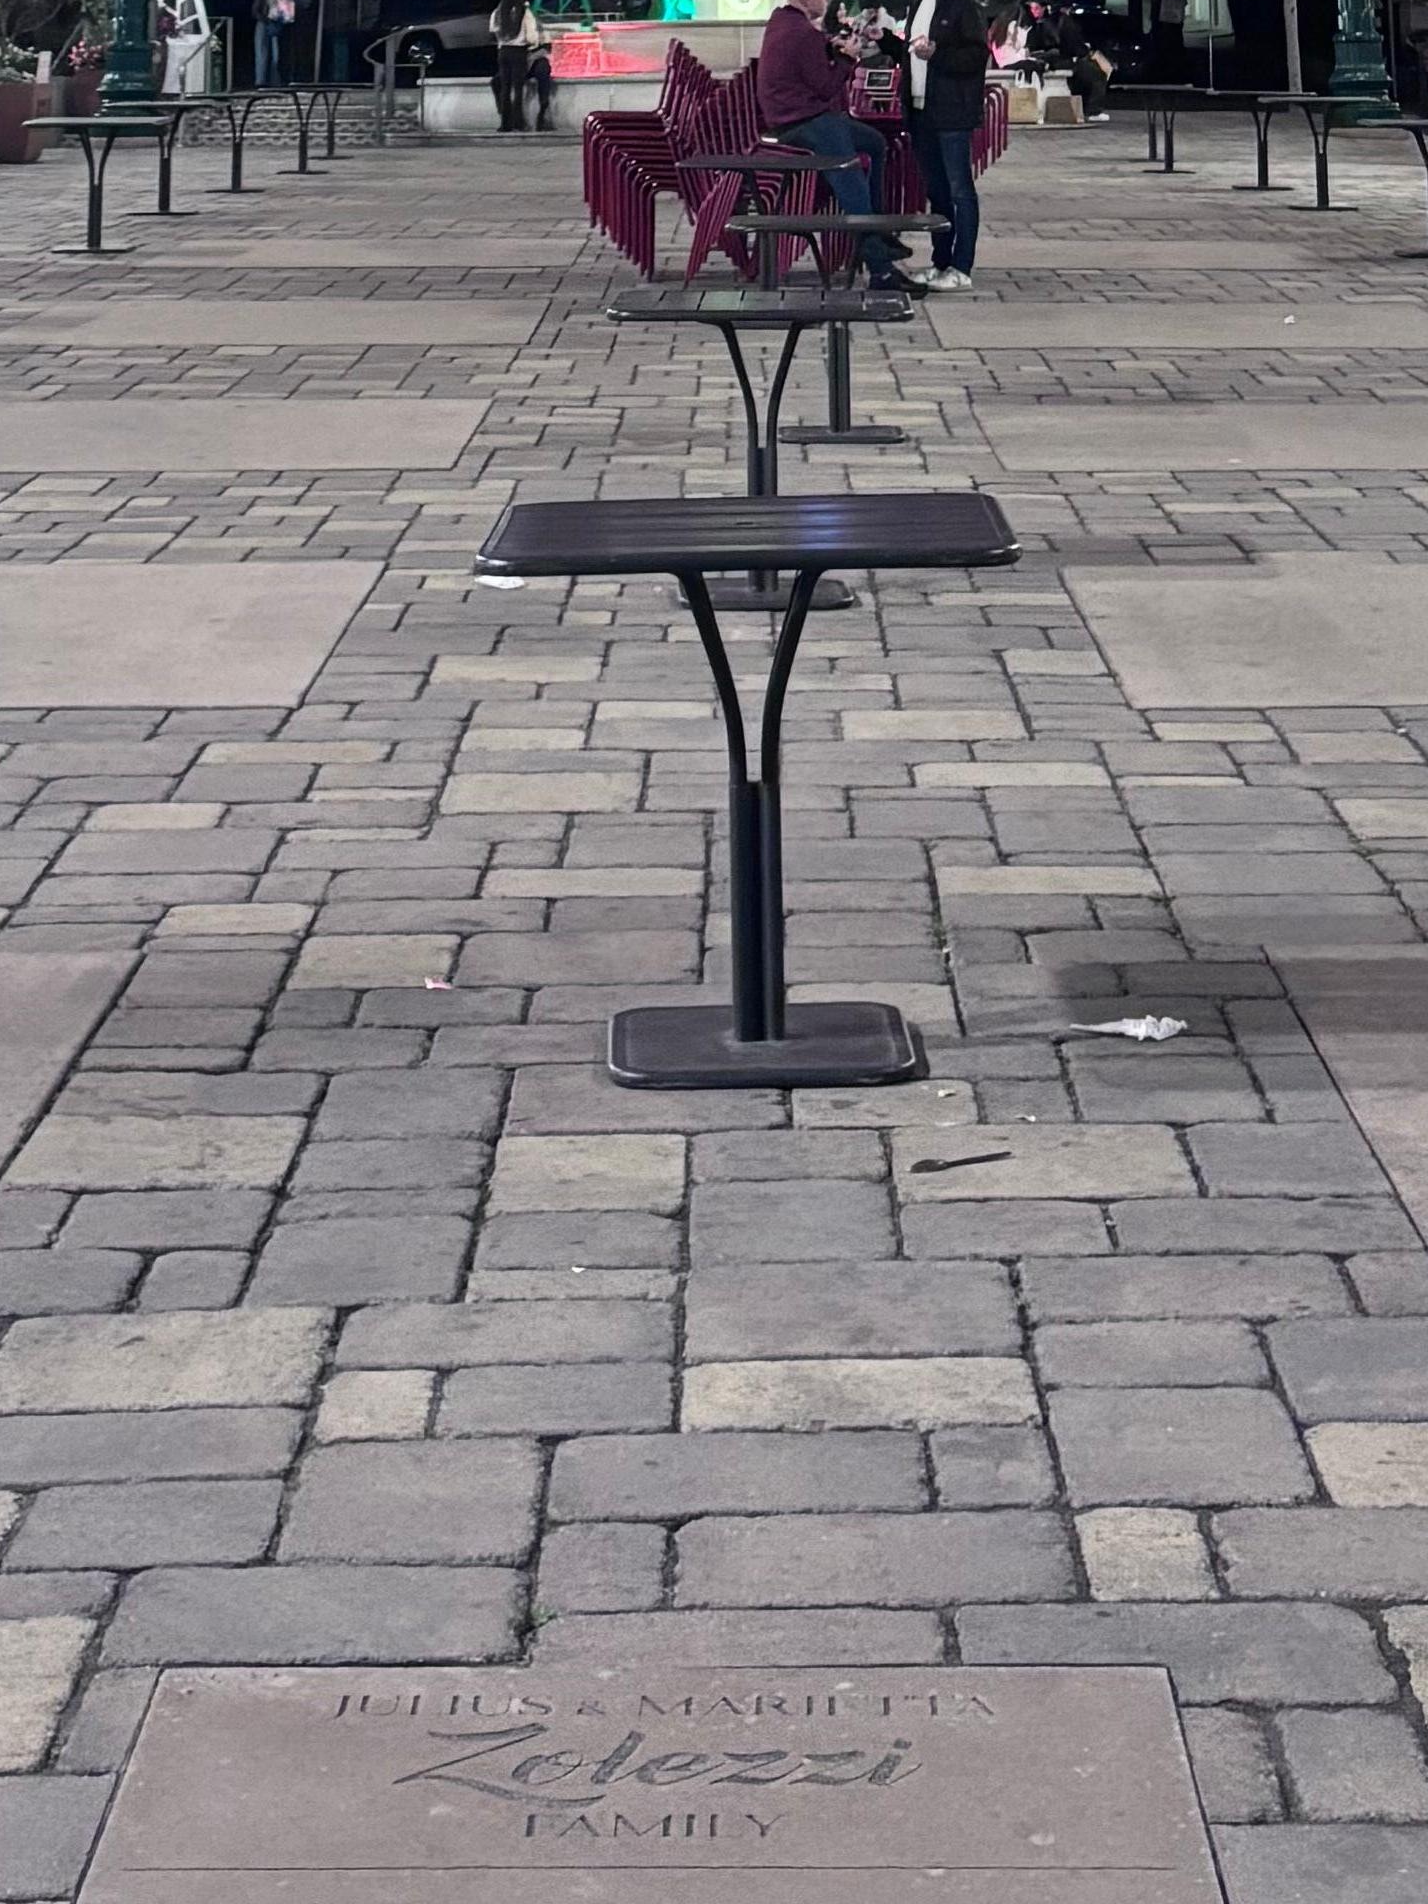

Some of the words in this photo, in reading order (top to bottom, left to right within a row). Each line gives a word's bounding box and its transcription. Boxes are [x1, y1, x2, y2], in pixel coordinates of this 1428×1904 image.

[329, 1692, 553, 1718] JULIUS
[576, 1697, 606, 1716] &
[638, 1694, 995, 1718] MARIETTA
[392, 1722, 923, 1809] Zolezzi
[523, 1812, 787, 1838] FAMILY
